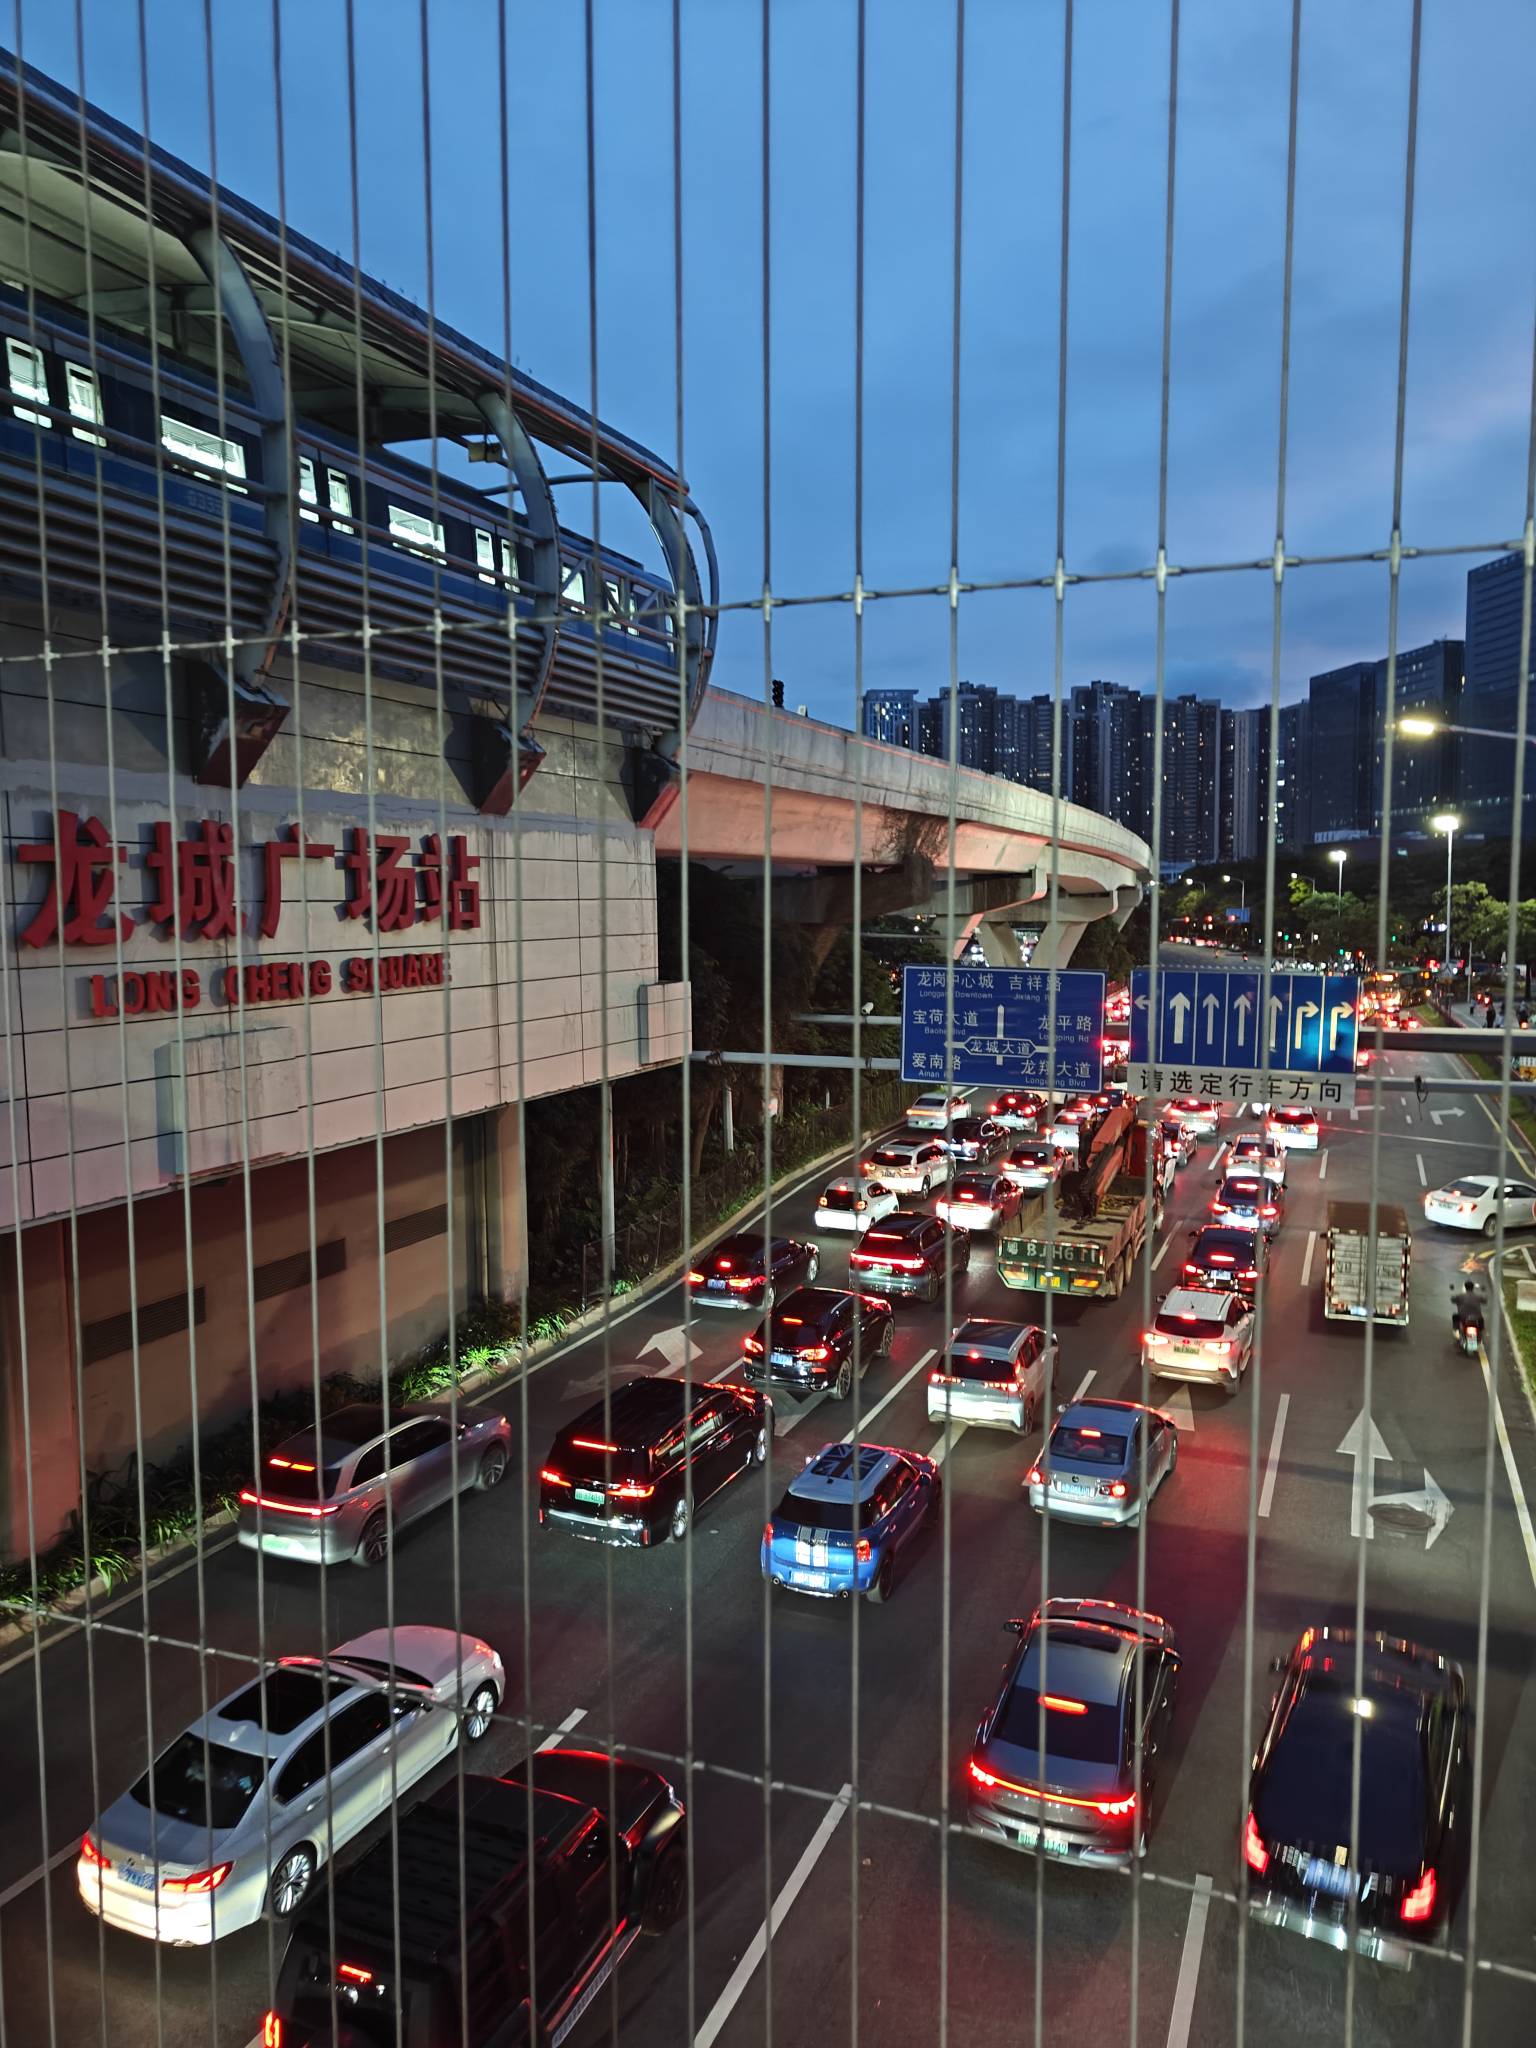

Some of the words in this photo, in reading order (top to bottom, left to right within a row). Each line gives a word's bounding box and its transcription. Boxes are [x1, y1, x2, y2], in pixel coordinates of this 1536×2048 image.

[18, 809, 481, 948] 龙城广场站
[92, 968, 200, 1018] LONG
[225, 960, 332, 1005] CHENG
[347, 952, 452, 992] SQUARE
[970, 1039, 1031, 1056] 龙城大道
[1140, 1068, 1342, 1103] 请选定行车方向
